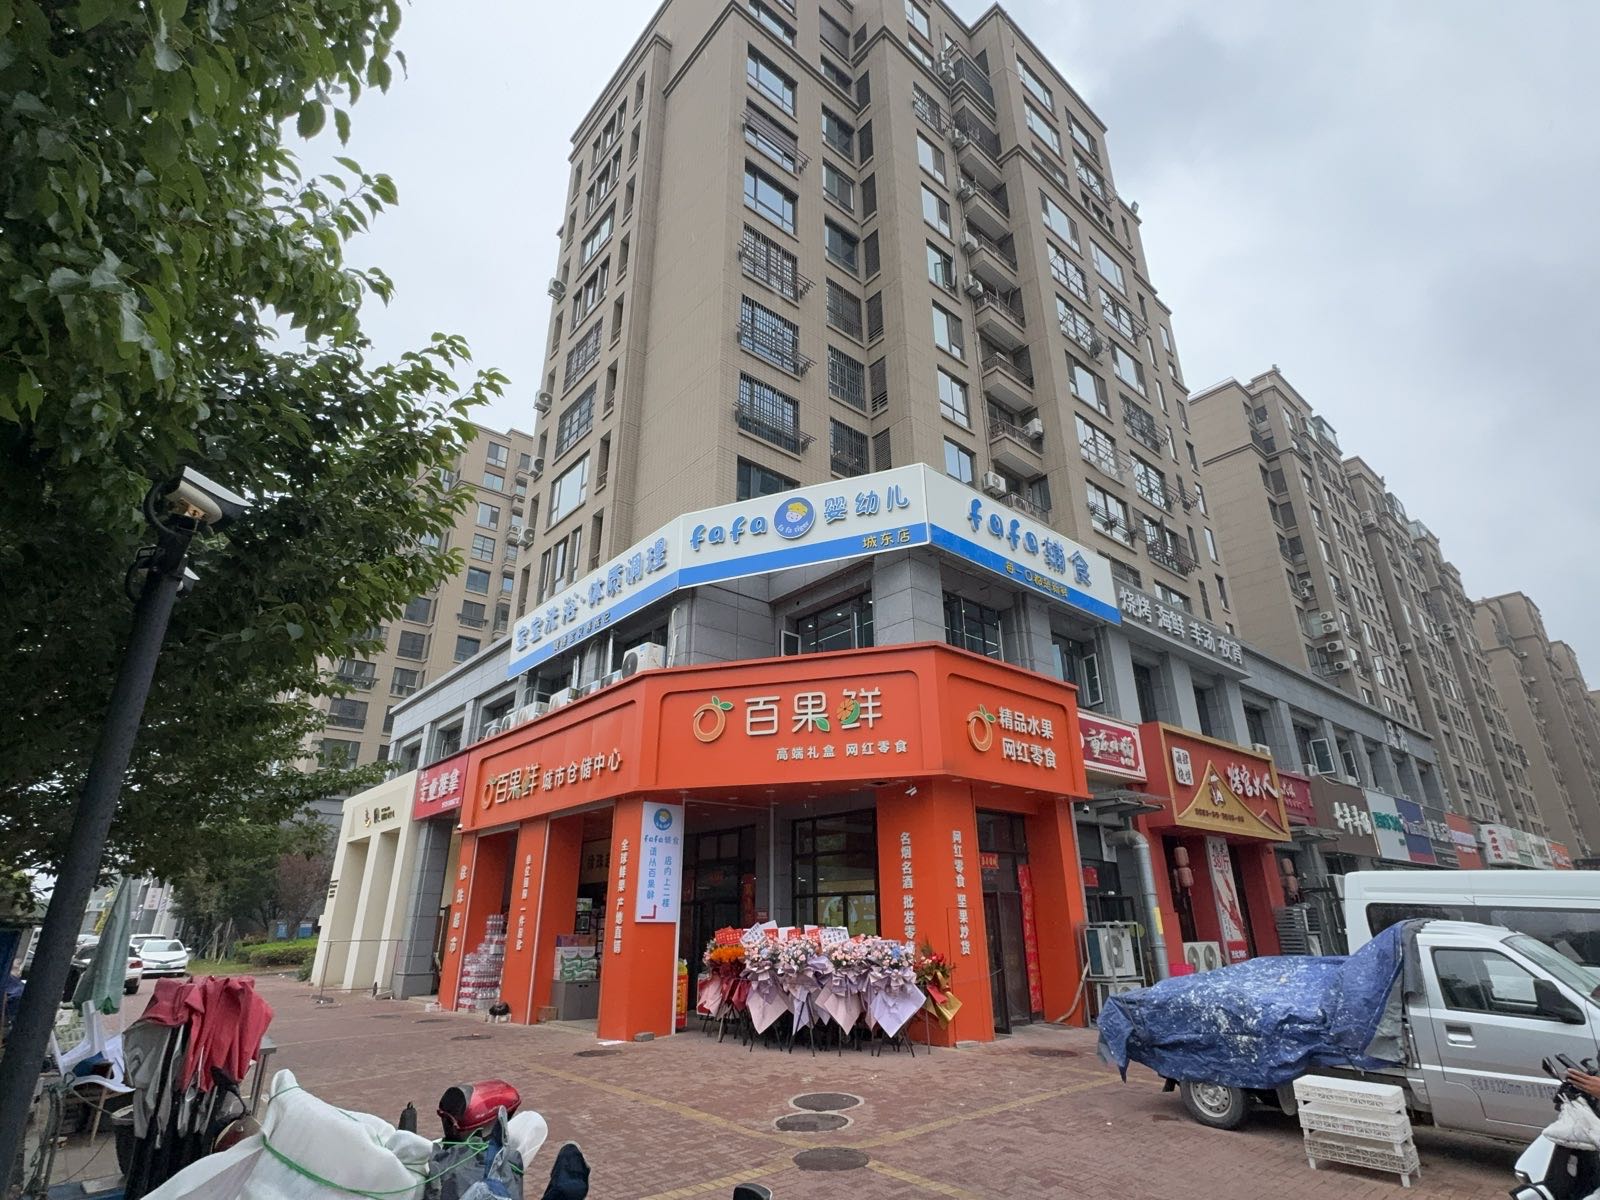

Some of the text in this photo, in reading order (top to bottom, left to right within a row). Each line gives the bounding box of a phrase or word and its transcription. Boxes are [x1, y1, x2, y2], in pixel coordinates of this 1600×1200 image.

[823, 484, 910, 524] 婴幼儿
[690, 514, 768, 551] fafa
[862, 528, 911, 549] 城东店
[967, 498, 1092, 586] fafa辅食
[1119, 587, 1243, 665] 烧烤 海鲜 羊汤 夜宵
[745, 687, 882, 737] 百果鲜
[999, 706, 1054, 740] 精品水果
[775, 740, 908, 761] 高端礼盒 网红零食
[1002, 740, 1057, 770] 网红零食
[495, 748, 623, 804] 百果鲜 城市仓储中心
[661, 856, 672, 908] 店内上二楼
[899, 831, 913, 889] 名烟名酒
[951, 830, 970, 956] 网红零食 坚果炒货
